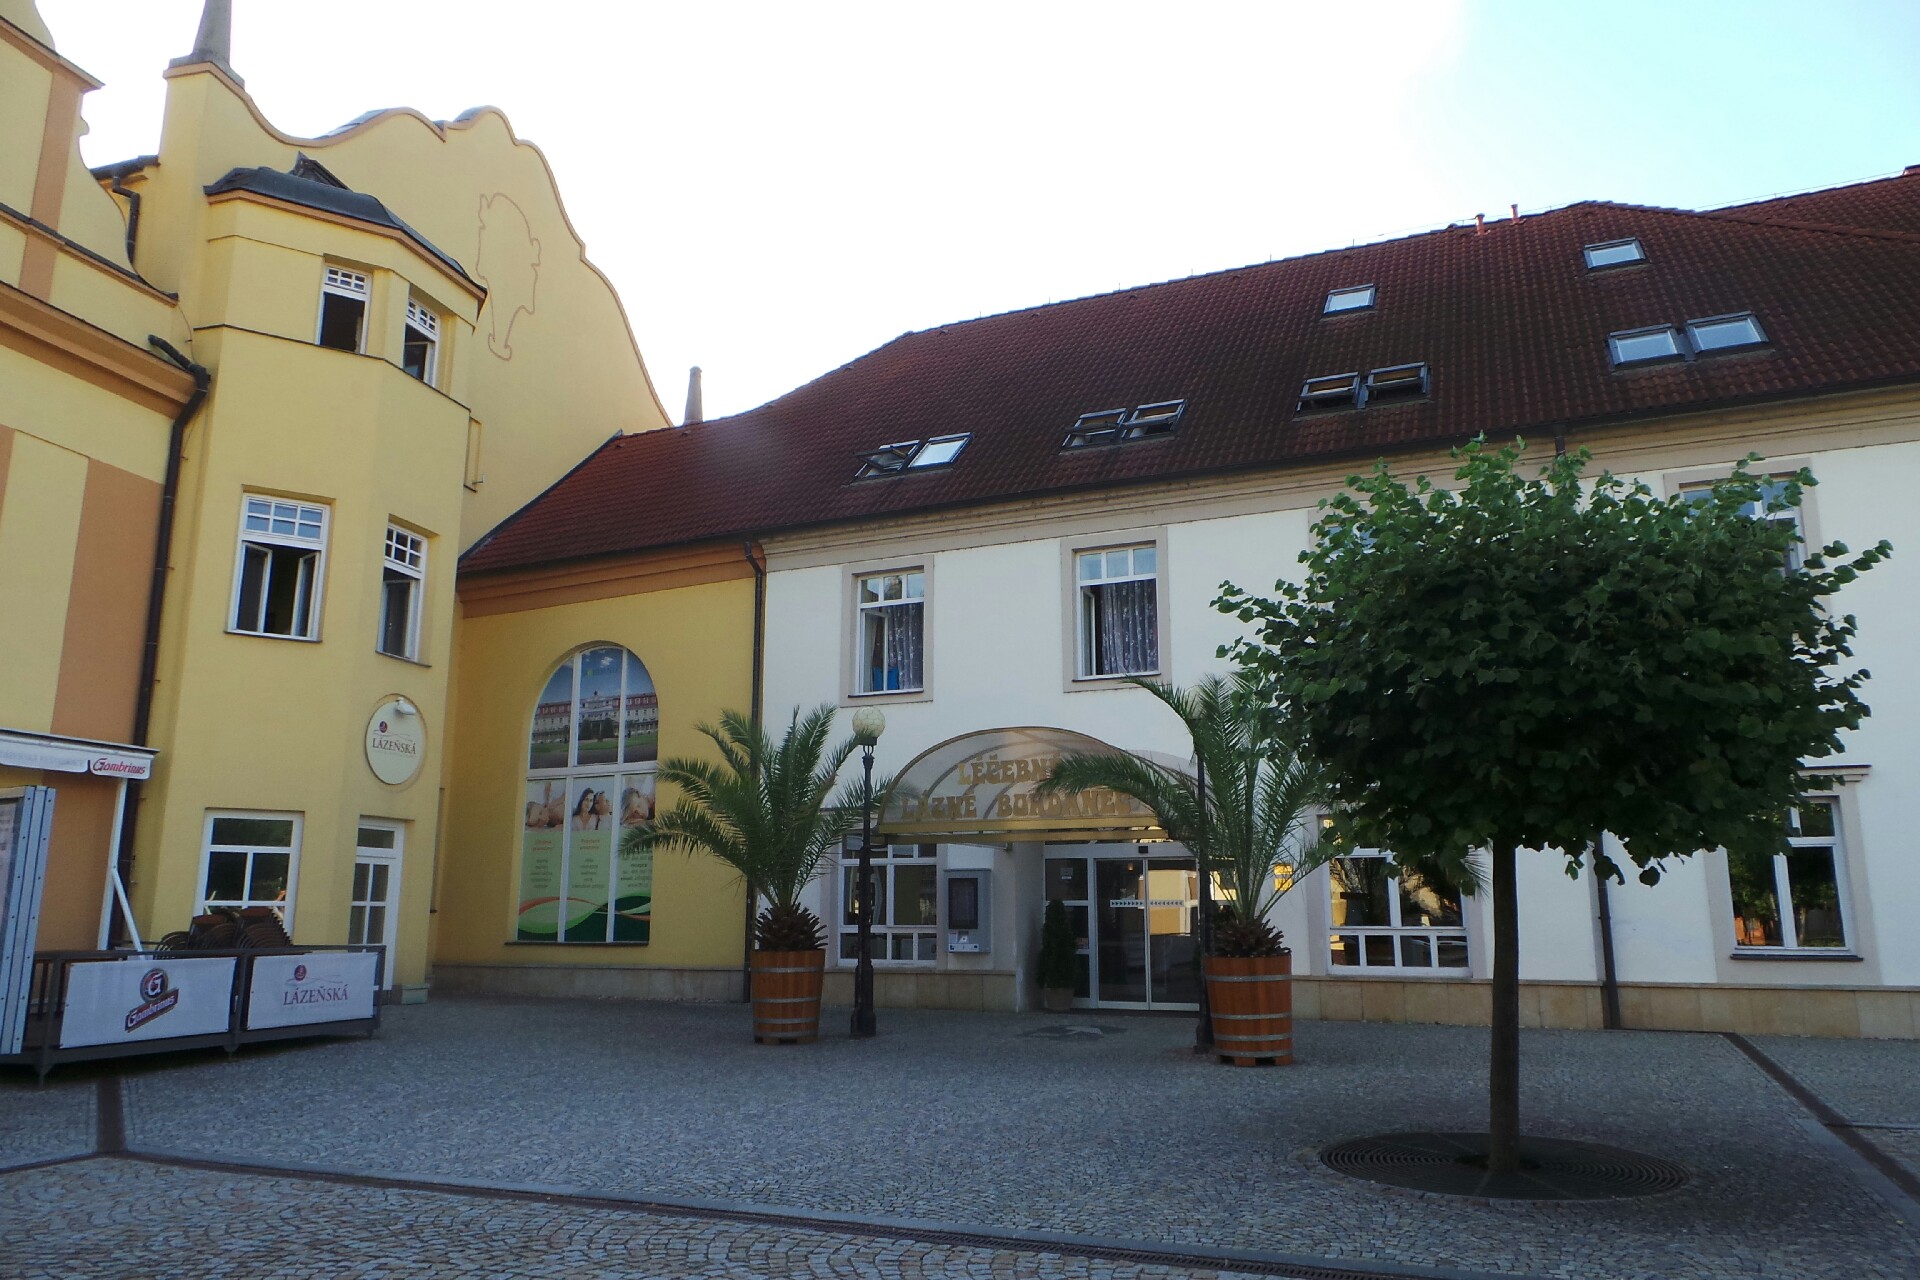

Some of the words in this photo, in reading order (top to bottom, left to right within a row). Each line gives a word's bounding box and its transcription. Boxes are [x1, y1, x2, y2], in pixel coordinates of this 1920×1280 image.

[372, 737, 417, 755] LÁZEŇSKÁ
[92, 757, 146, 775] Gambrinus
[282, 983, 349, 1006] LÁZEŇSKÁ
